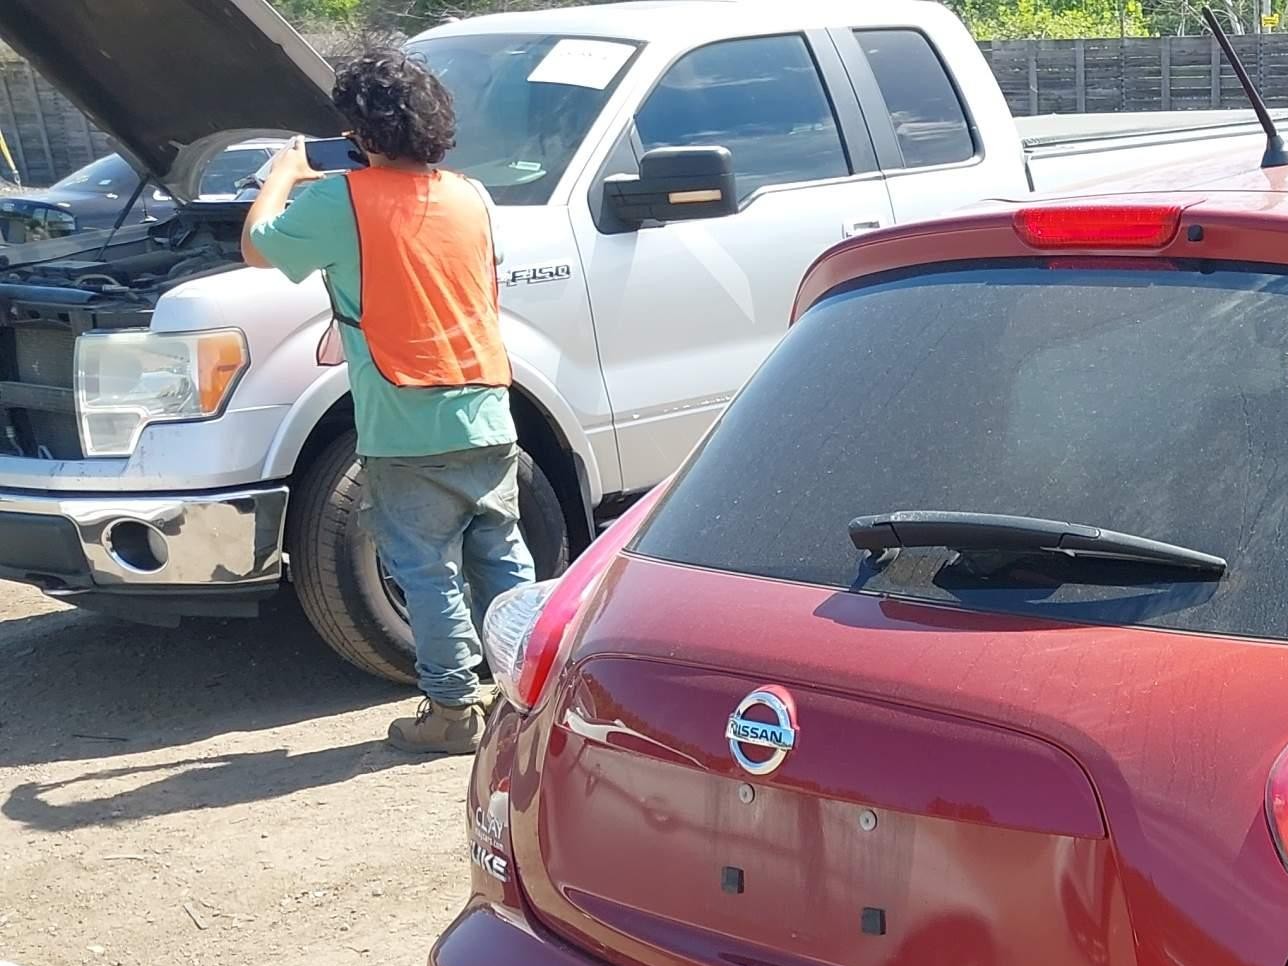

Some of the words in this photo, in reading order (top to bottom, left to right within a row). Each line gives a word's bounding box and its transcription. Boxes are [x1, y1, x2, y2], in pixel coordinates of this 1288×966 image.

[730, 719, 783, 743] NISSAN
[475, 806, 504, 839] CLAY
[469, 840, 507, 883] UKE
